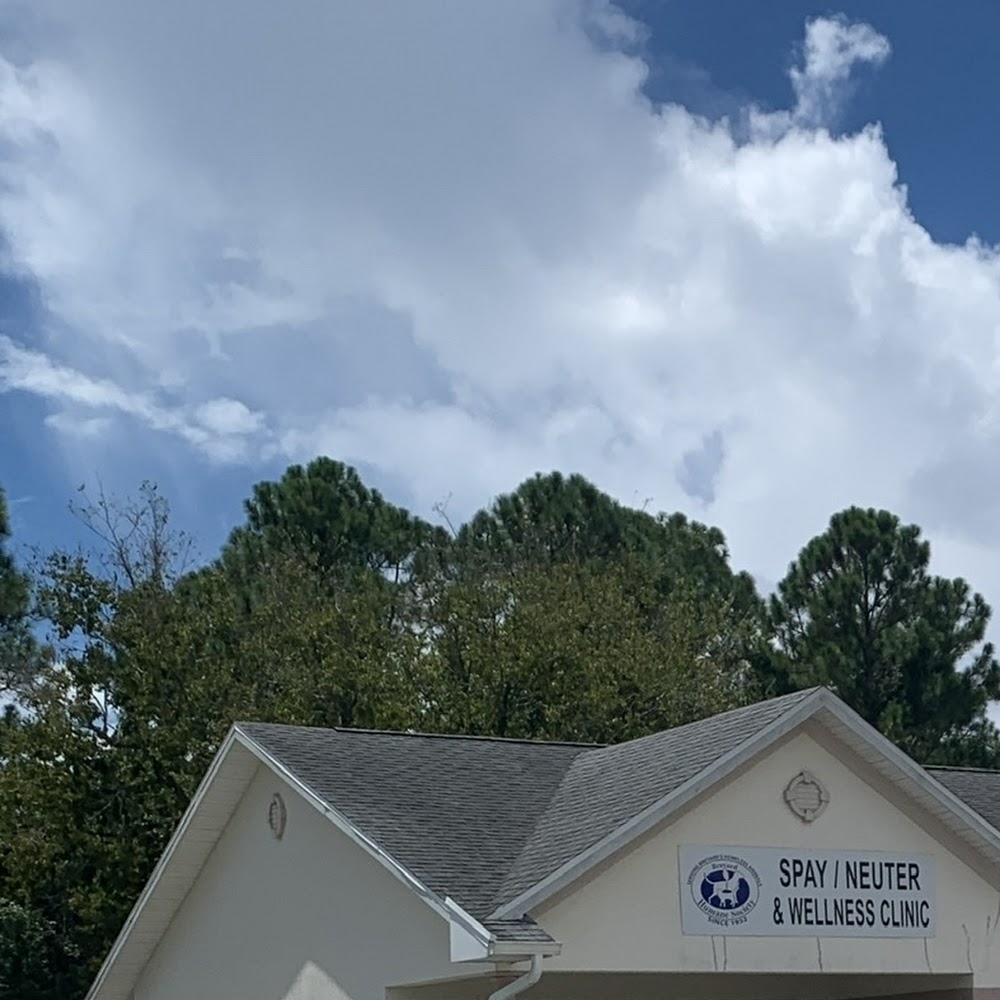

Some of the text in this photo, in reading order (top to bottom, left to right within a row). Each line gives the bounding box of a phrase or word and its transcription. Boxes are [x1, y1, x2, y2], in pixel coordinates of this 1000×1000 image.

[779, 858, 921, 890] SPAY / NEUTER
[697, 899, 755, 919] Humane Society
[773, 897, 930, 928] & WELLNESS CLINIC
